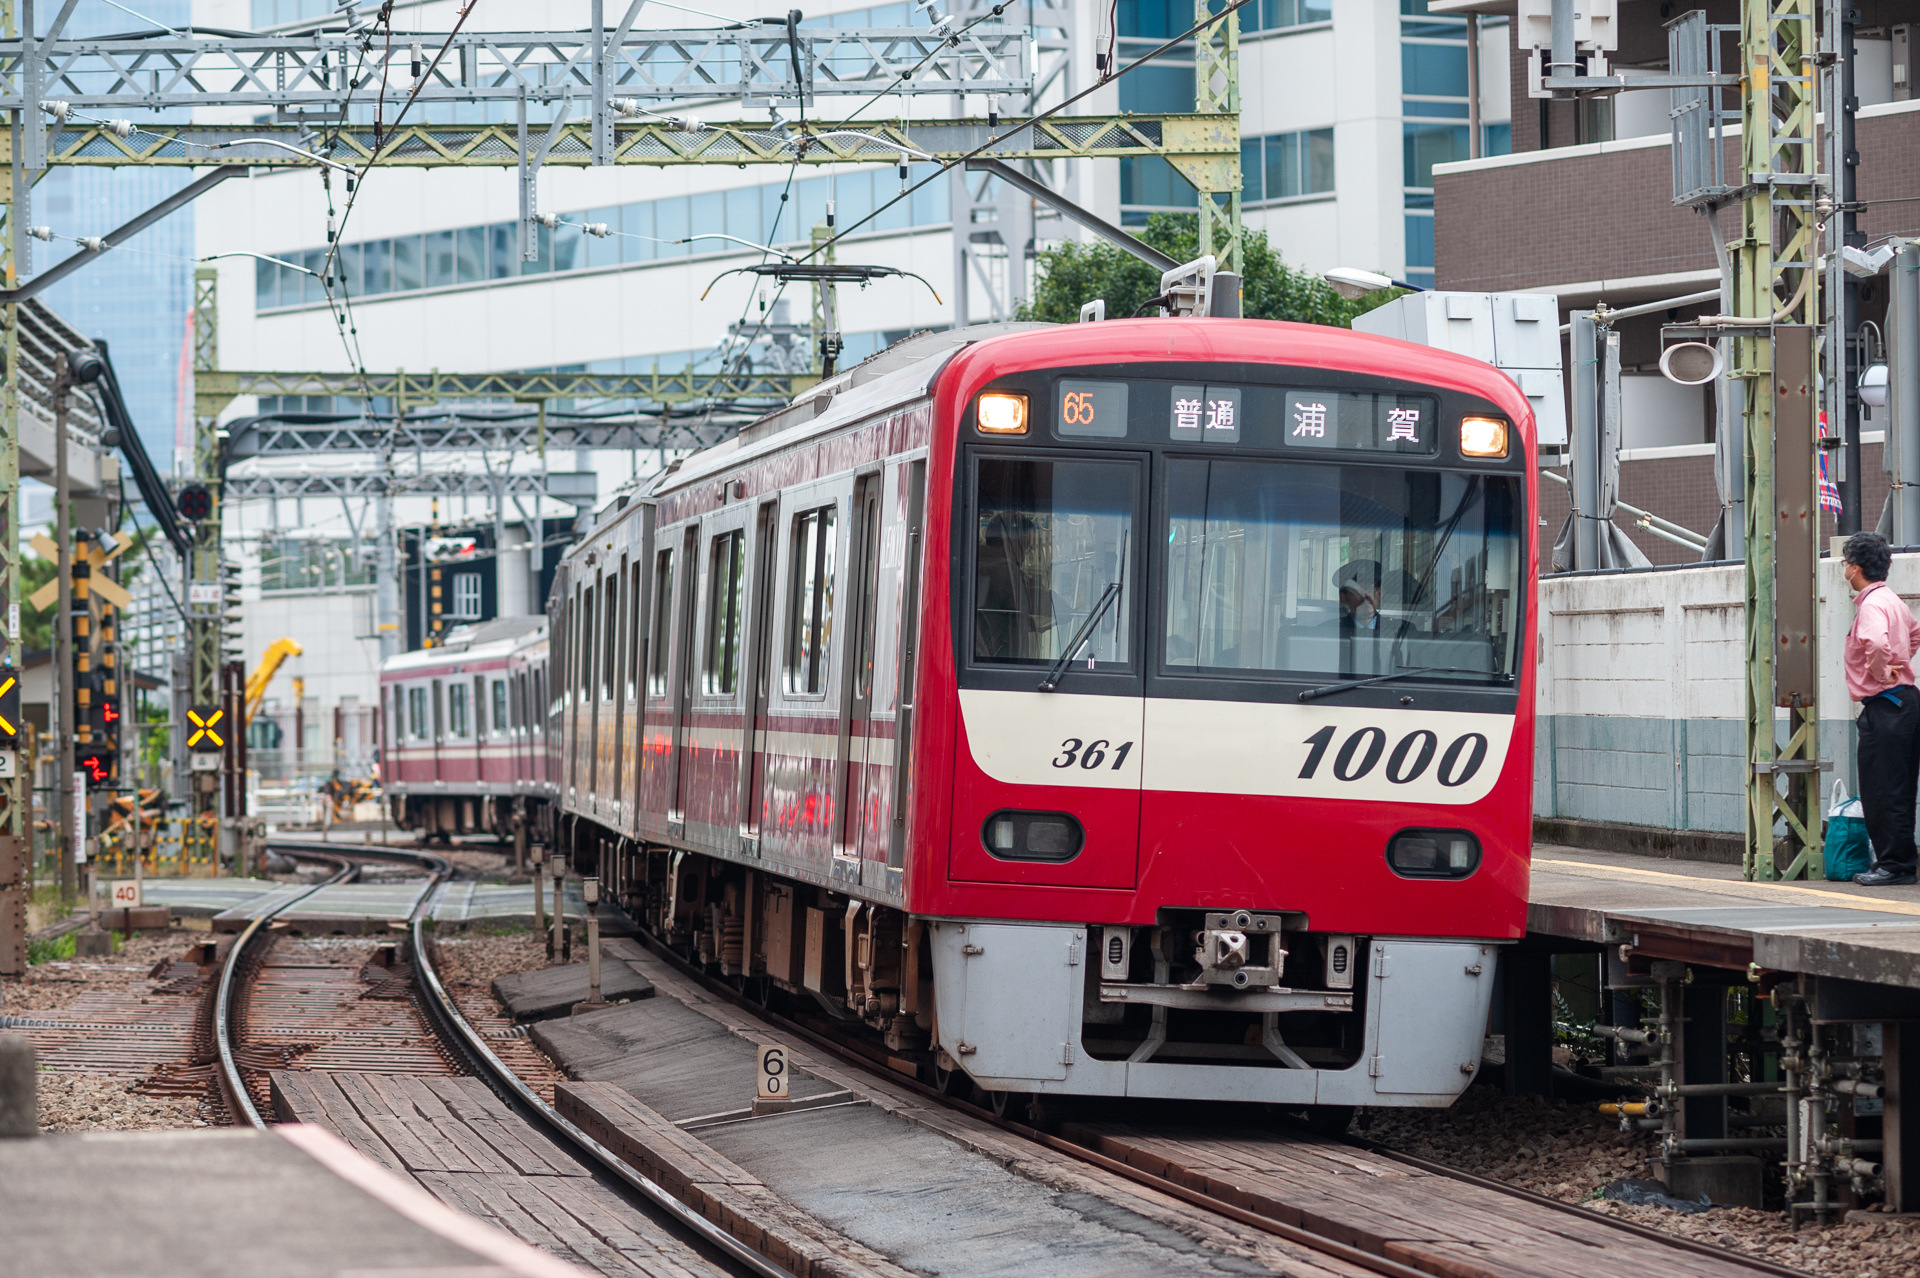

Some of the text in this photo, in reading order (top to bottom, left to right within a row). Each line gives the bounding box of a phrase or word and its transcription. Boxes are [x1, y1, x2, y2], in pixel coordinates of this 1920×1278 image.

[1063, 392, 1094, 424] 65
[1173, 399, 1235, 430] 普通
[1292, 402, 1420, 443] 浦賀
[1052, 737, 1134, 770] 361
[1297, 725, 1488, 788] 1000
[116, 886, 136, 901] 40
[763, 1048, 784, 1076] 6
[767, 1076, 780, 1093] 0
